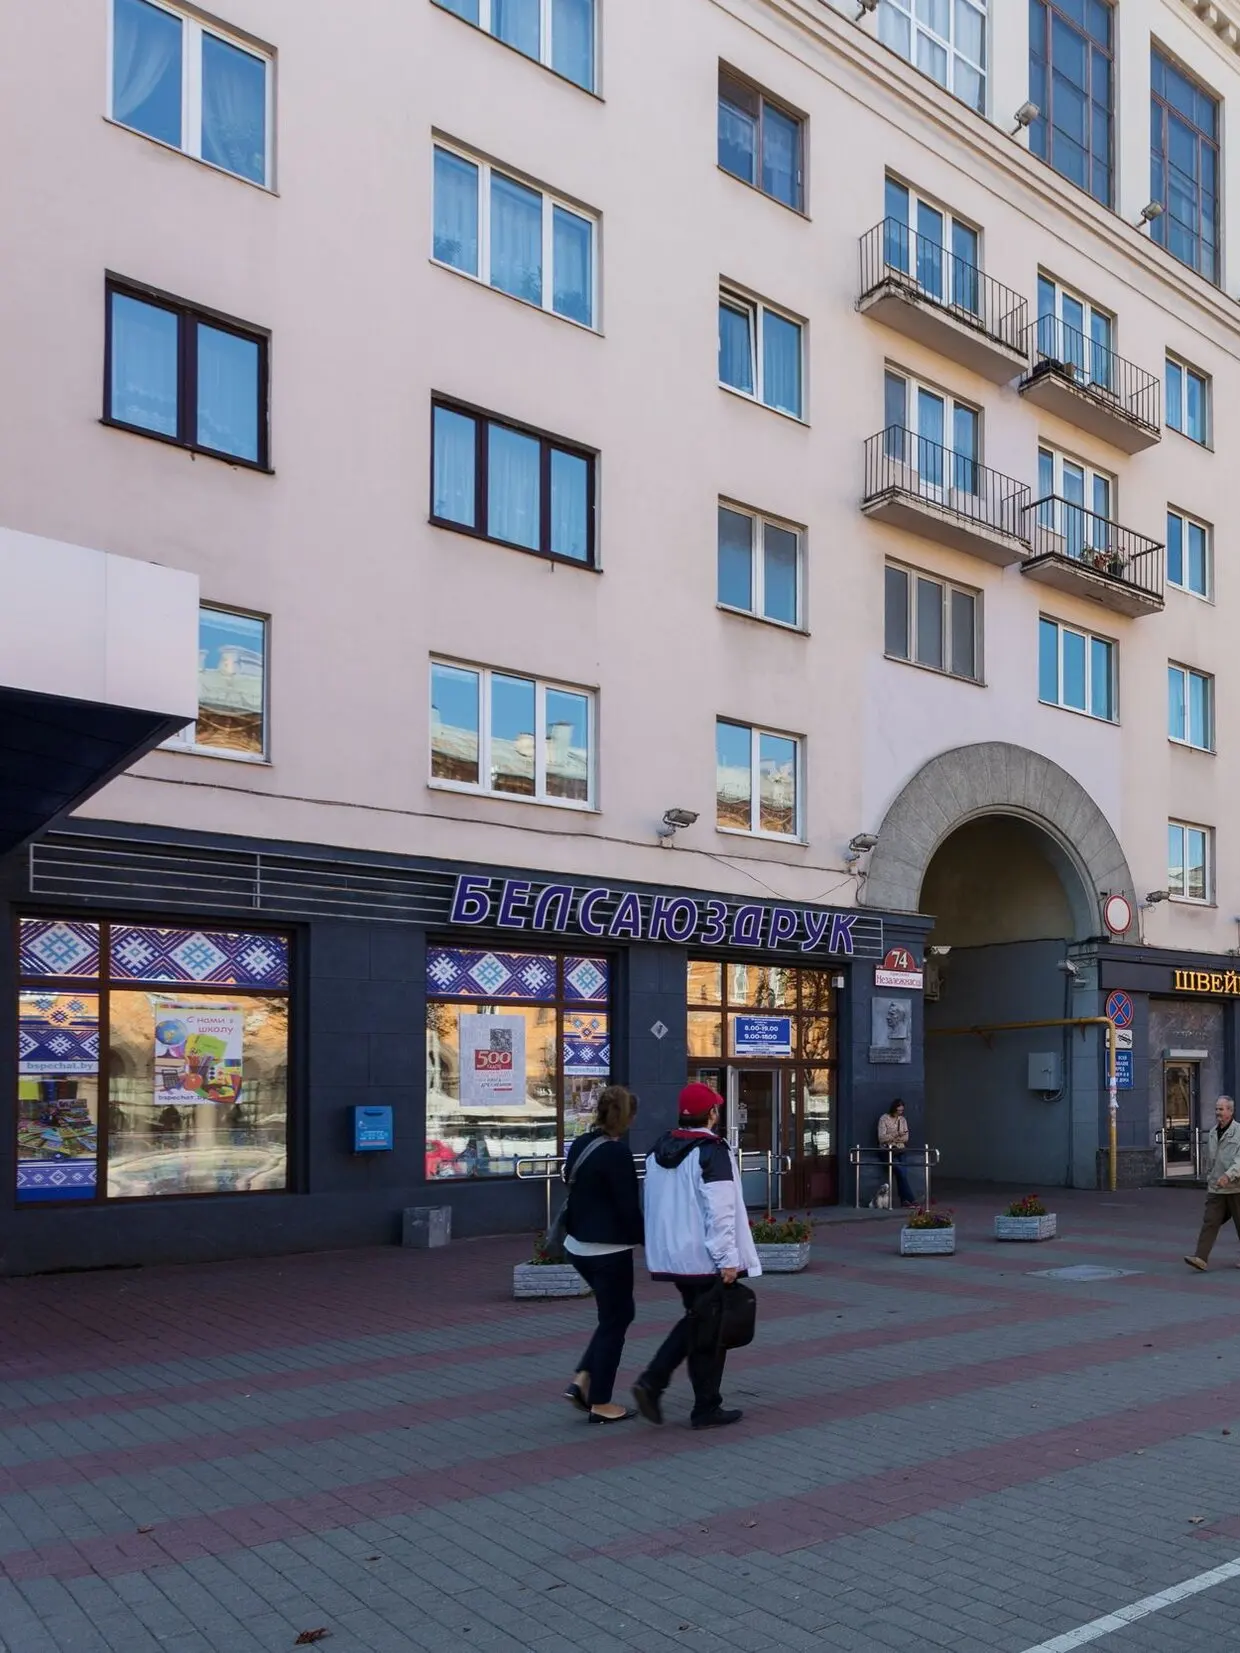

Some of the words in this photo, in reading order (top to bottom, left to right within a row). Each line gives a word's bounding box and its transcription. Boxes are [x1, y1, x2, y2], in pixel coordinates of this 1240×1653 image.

[450, 874, 857, 955] БЕЛСАЮЗДРУК
[891, 951, 908, 968] 74
[198, 1026, 234, 1035] школу
[26, 1062, 93, 1072] bspechat.by
[476, 1051, 512, 1068] 500
